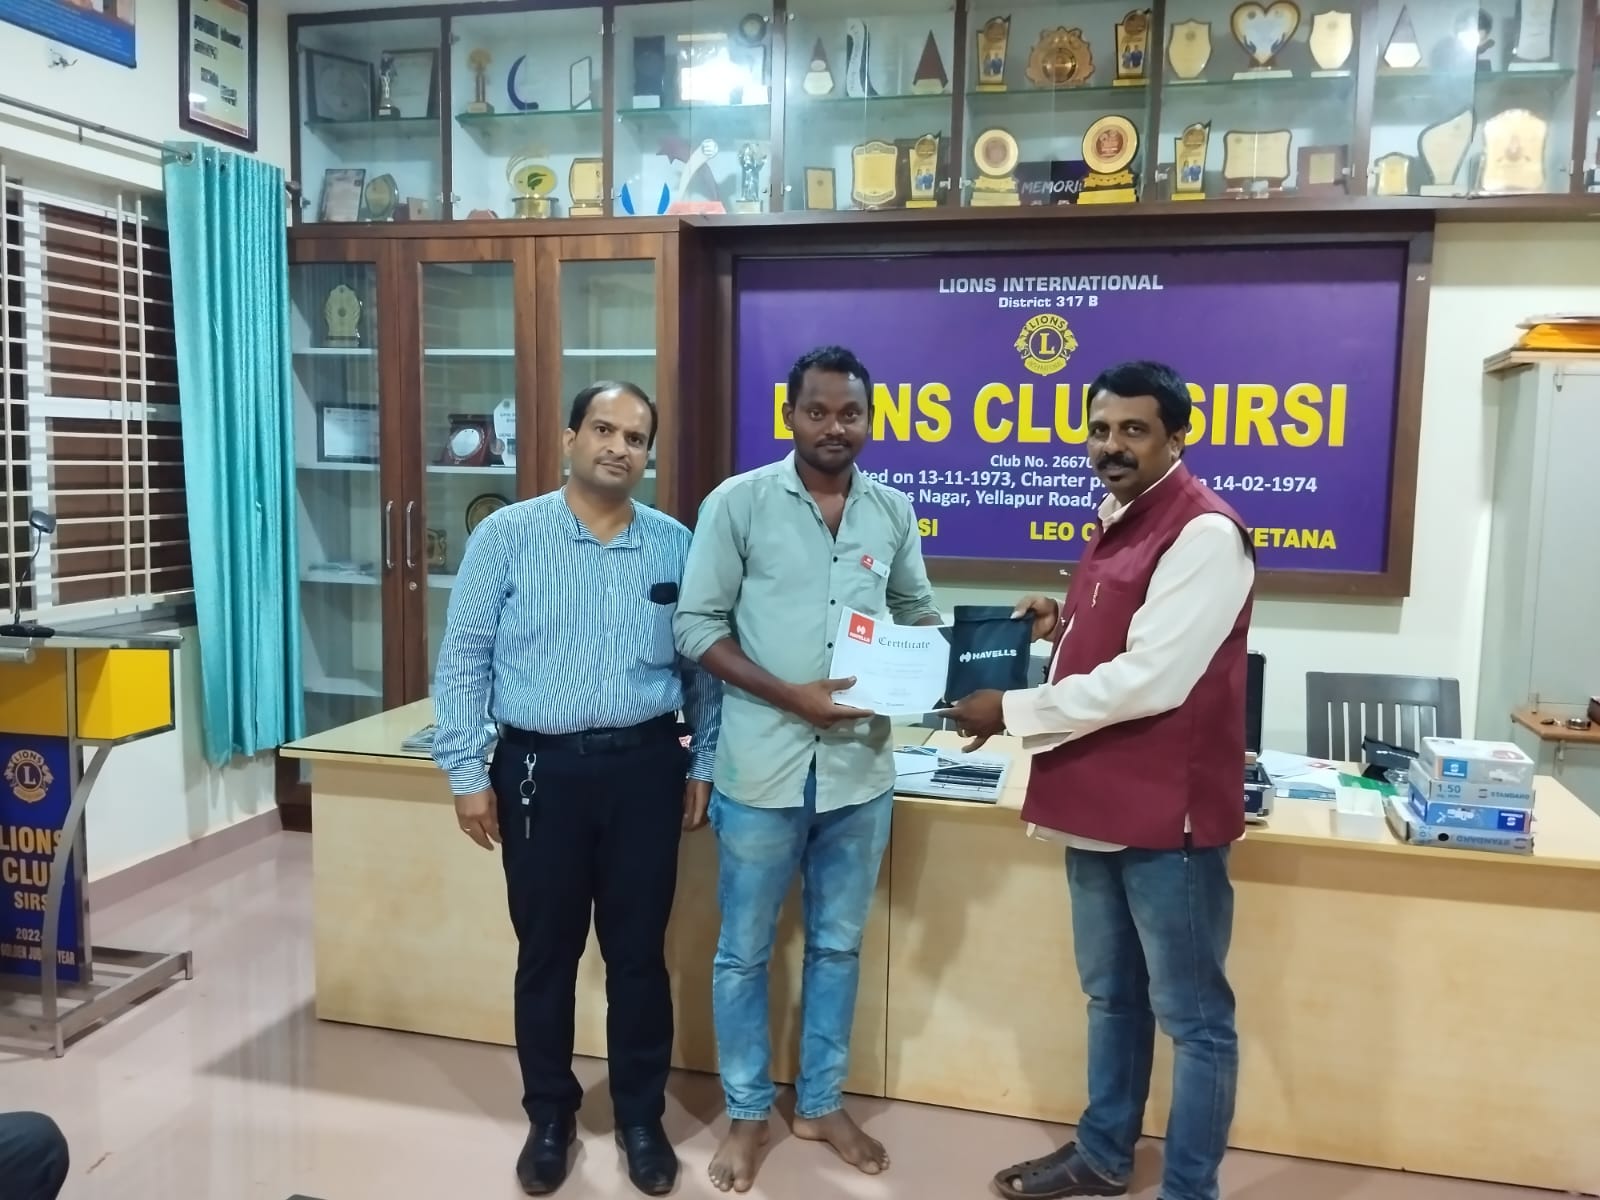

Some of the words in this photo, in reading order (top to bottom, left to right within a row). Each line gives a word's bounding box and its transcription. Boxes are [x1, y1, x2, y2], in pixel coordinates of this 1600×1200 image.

[939, 278, 997, 293] LIONS
[1003, 275, 1163, 292] INTERNATIONAL
[998, 296, 1051, 308] District
[1056, 296, 1083, 307] 317
[1088, 295, 1098, 307] B
[1028, 315, 1066, 329] LIONS
[1038, 332, 1056, 355] L
[773, 382, 952, 443] LNS
[973, 382, 1092, 445] CLU
[990, 454, 1021, 468] Club
[1024, 456, 1048, 468] No.
[893, 472, 914, 484] on
[918, 470, 1016, 489] 13-11-1973,
[1021, 471, 1086, 488] Charter
[1213, 475, 1318, 493] 14-02-1974
[919, 489, 971, 507] Nagar,
[976, 489, 1044, 509] Yellapur
[1048, 491, 1097, 510] Road,
[1030, 521, 1075, 541] LEO
[1246, 527, 1337, 549] ETANA
[972, 649, 1017, 660] HAVELLS
[23, 765, 37, 786] L
[2, 856, 50, 887] CLU
